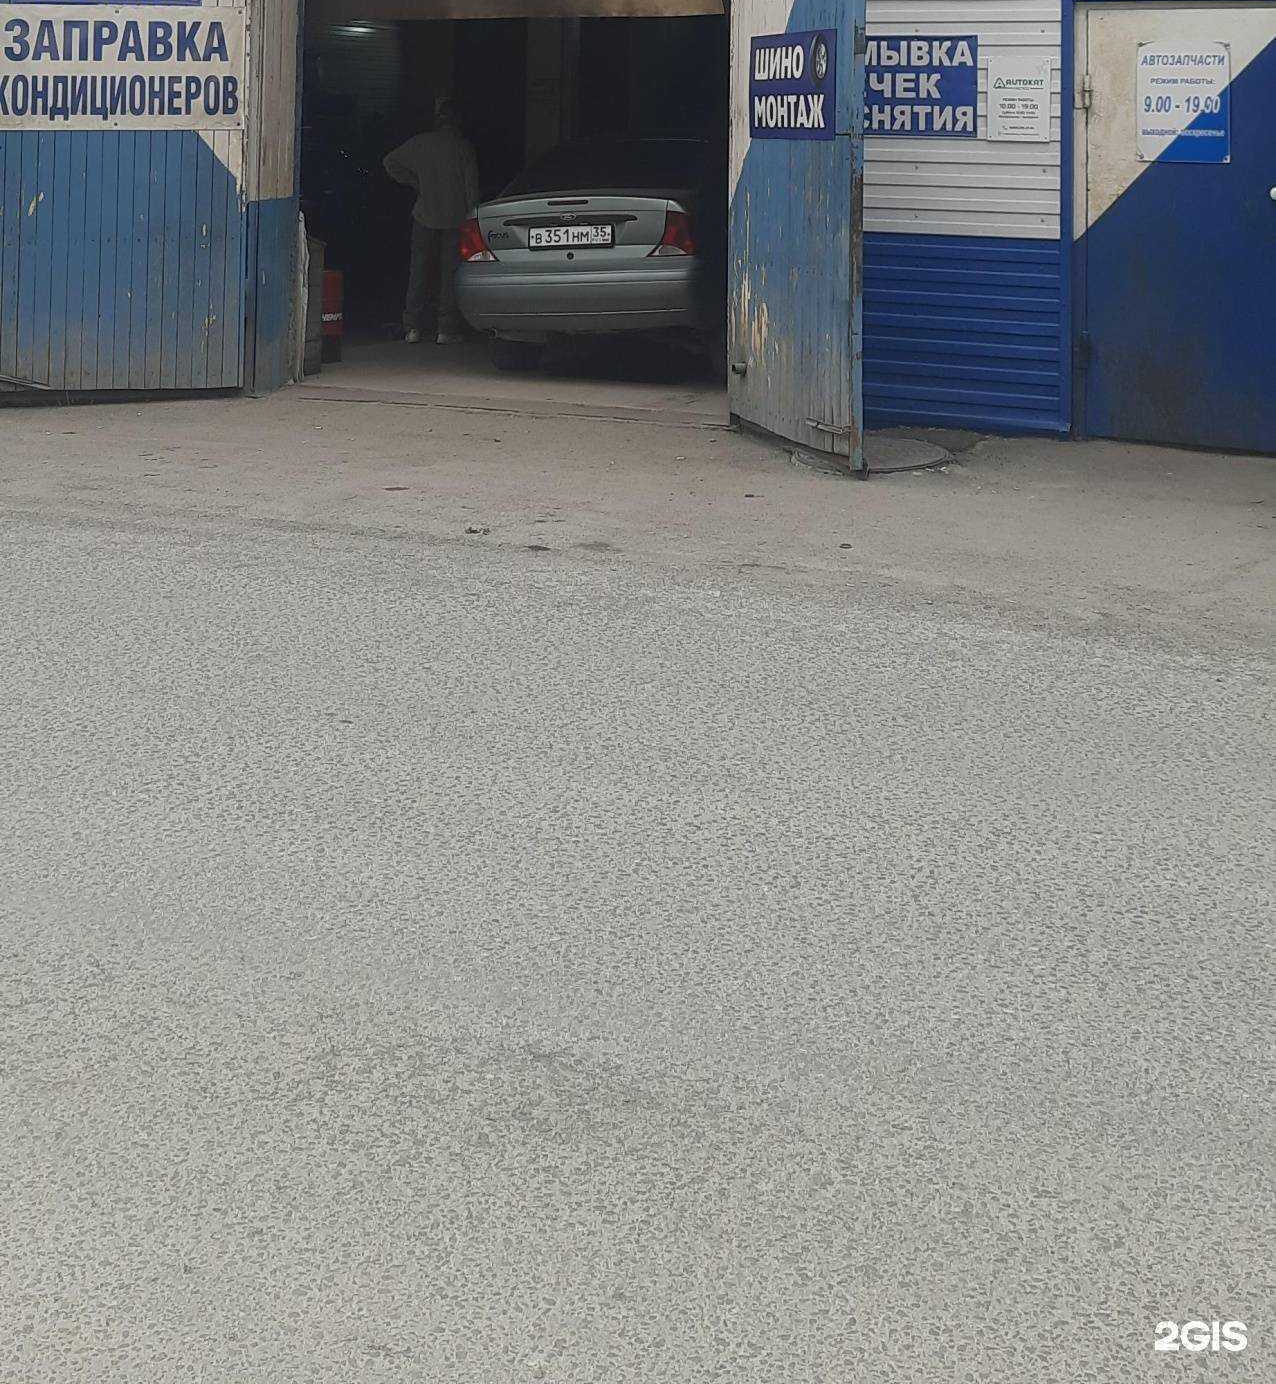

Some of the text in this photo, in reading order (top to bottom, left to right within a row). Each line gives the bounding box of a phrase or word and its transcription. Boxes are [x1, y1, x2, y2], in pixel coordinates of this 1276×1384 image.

[4, 18, 230, 62] ЗАПРАВКА
[754, 45, 805, 81] ШИНО
[1141, 55, 1225, 66] АВТОЗАПЧАСТИ
[754, 94, 826, 129] МОНТАЖ
[1144, 96, 1172, 113] 9.00
[1184, 96, 1221, 114] 19.00
